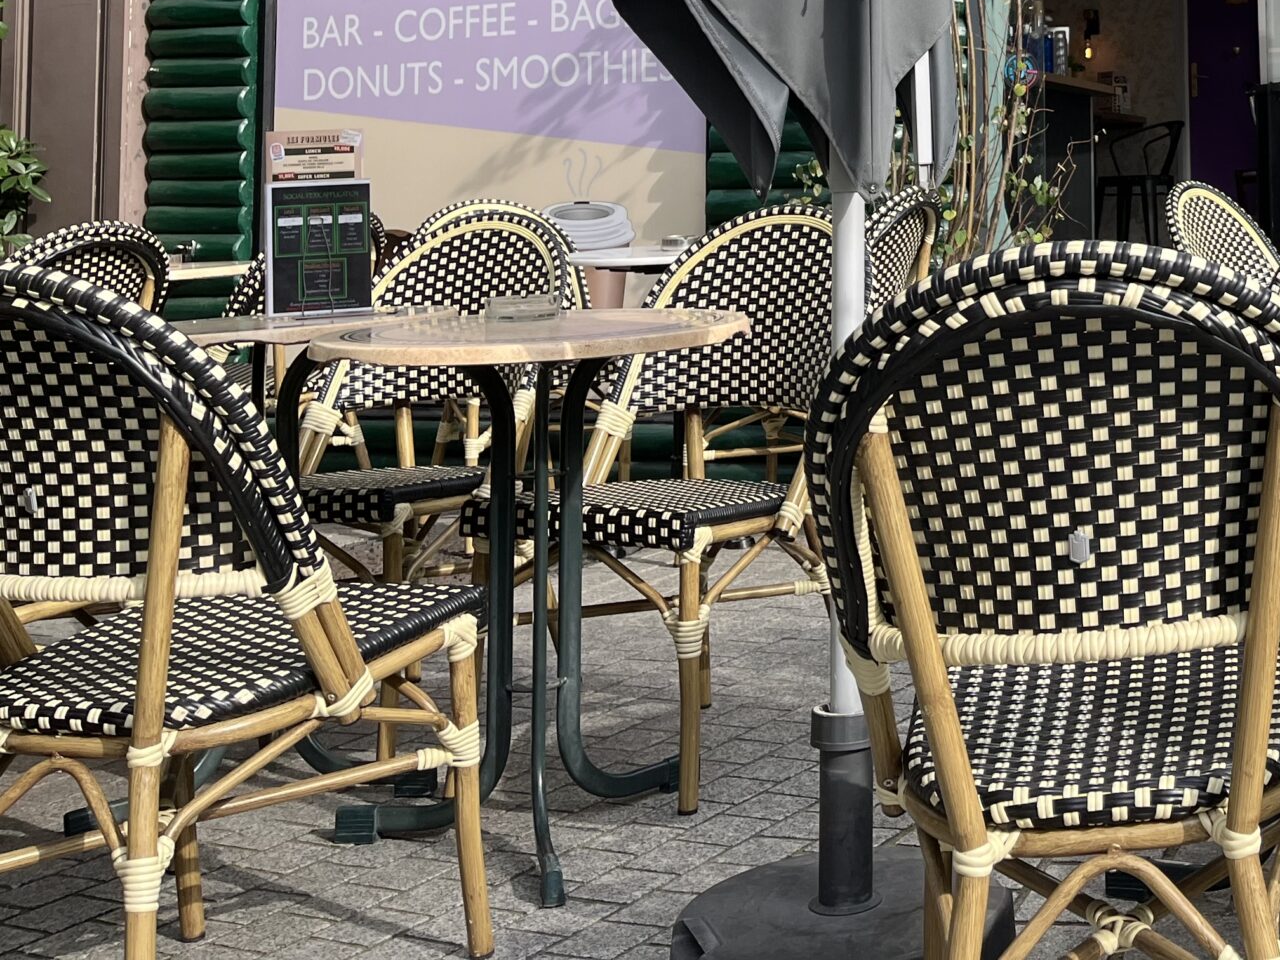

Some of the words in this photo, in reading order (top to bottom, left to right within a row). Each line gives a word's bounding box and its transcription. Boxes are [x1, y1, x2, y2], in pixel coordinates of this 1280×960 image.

[302, 14, 363, 49] BAR
[394, 2, 517, 43] COFFEE
[303, 60, 443, 101] DONUTS
